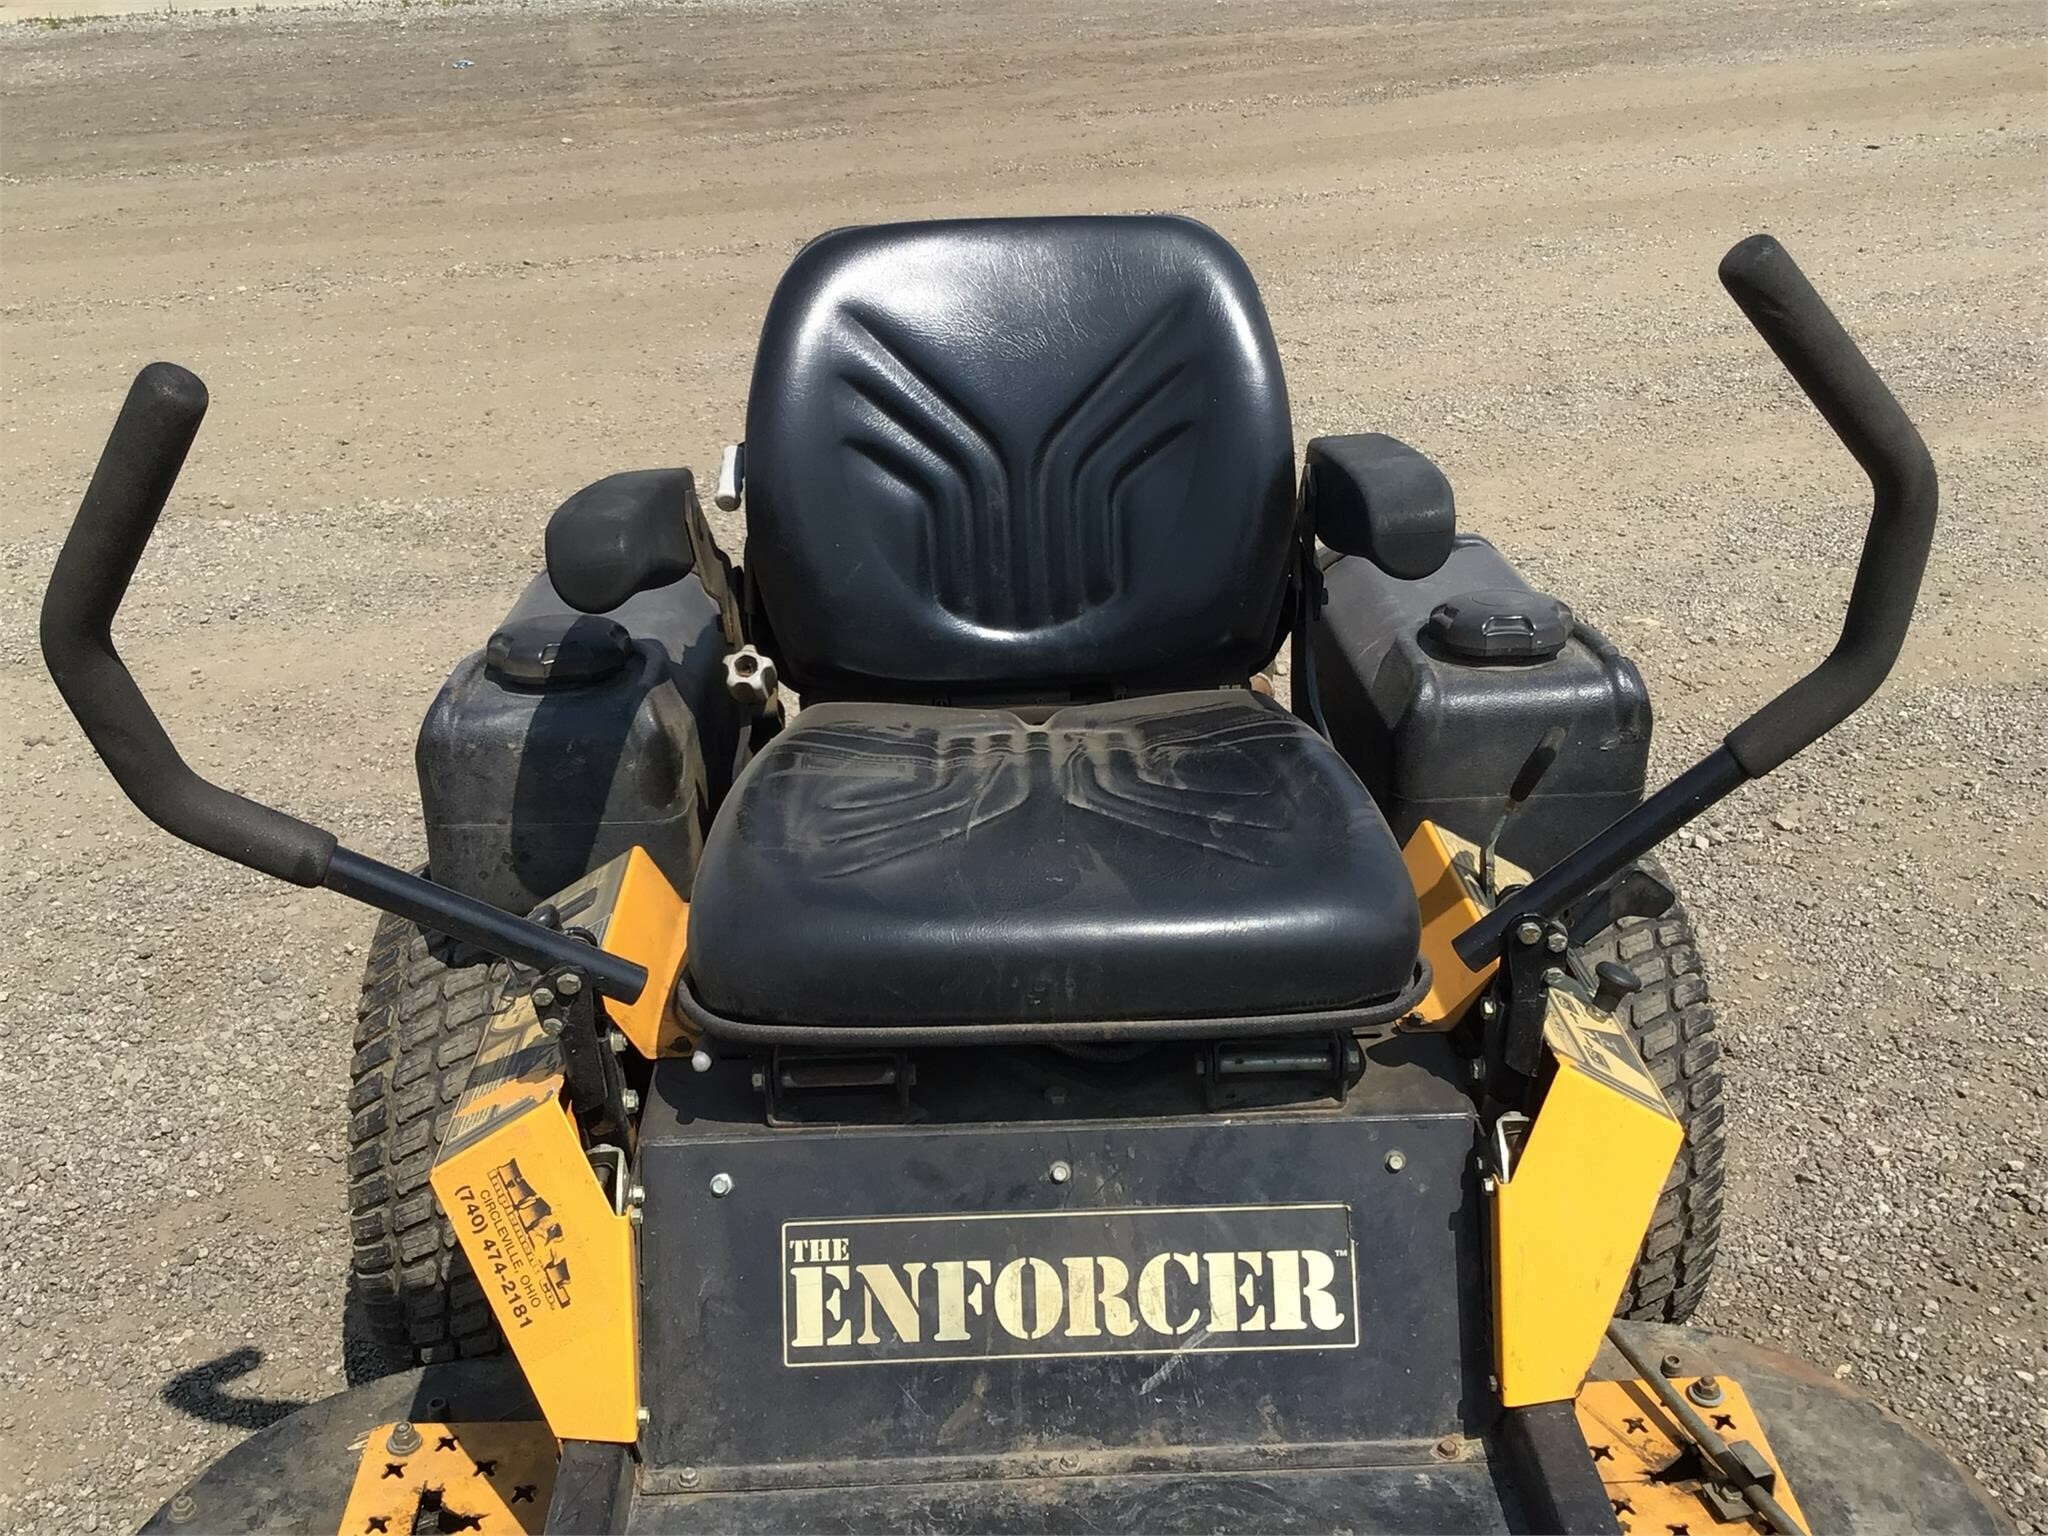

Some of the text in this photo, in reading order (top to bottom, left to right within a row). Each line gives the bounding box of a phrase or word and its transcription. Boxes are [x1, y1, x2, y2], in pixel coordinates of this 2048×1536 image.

[454, 1185, 490, 1234] (740)
[483, 1239, 533, 1328] 474-2181
[479, 1189, 542, 1308] CIRCLEVILLE, OHIO
[487, 1168, 541, 1275] Implemen
[789, 1238, 850, 1263] THE
[790, 1249, 1346, 1347] ENFORCER
